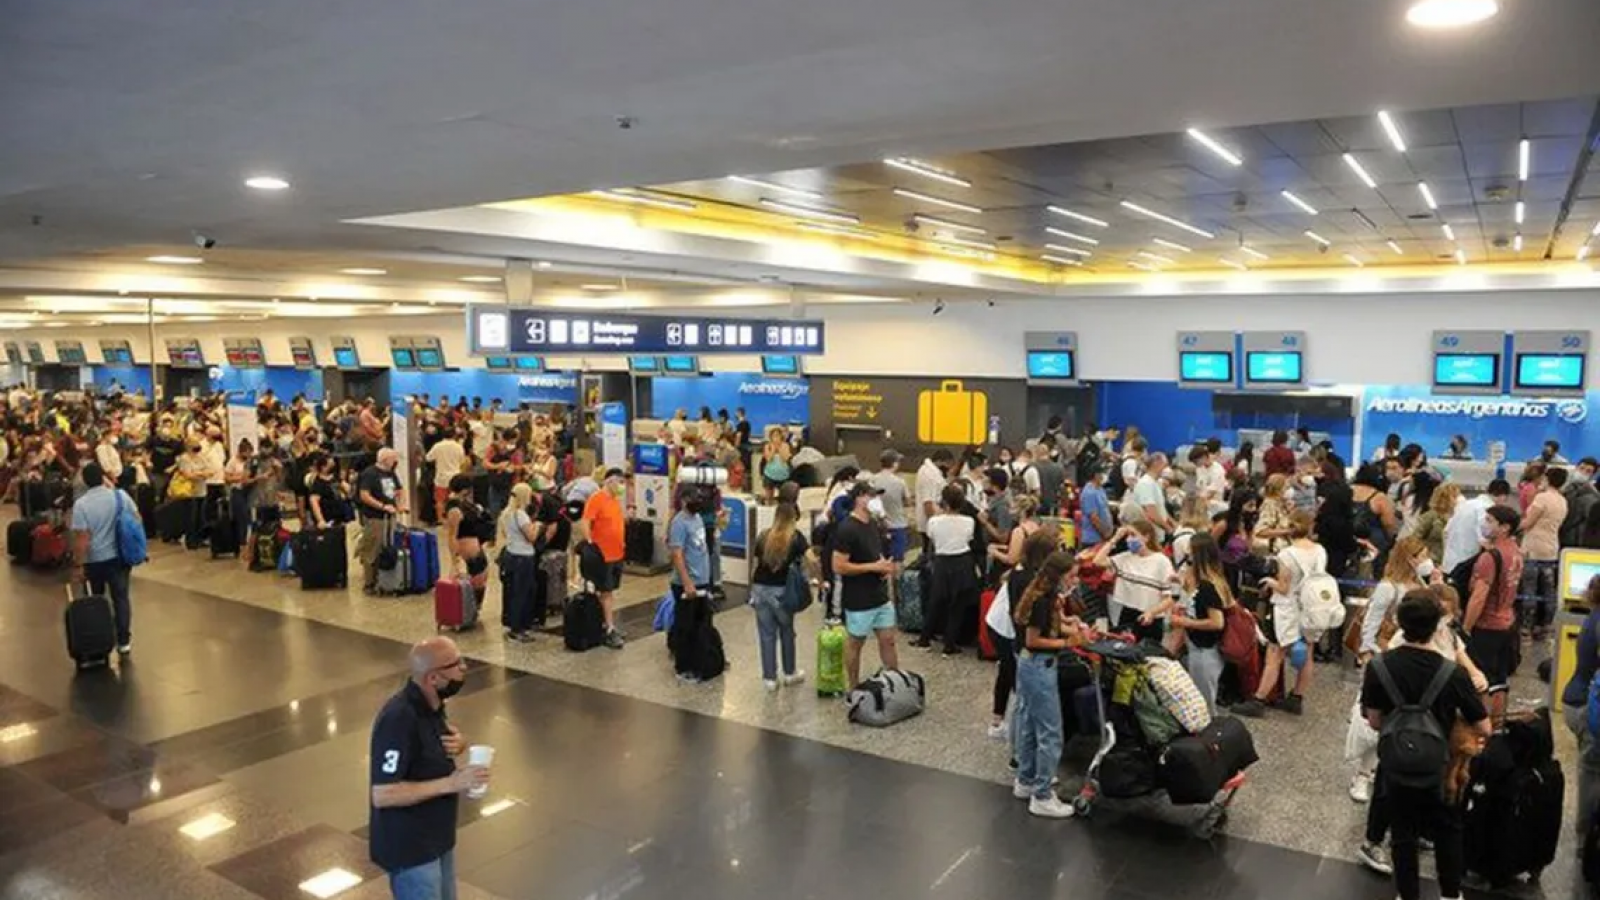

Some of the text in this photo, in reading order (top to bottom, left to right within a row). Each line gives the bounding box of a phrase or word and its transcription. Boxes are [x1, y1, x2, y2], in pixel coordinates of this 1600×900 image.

[1183, 336, 1198, 346] 47
[1440, 337, 1459, 348] 49
[1562, 336, 1581, 348] 50
[382, 750, 399, 773] 3
